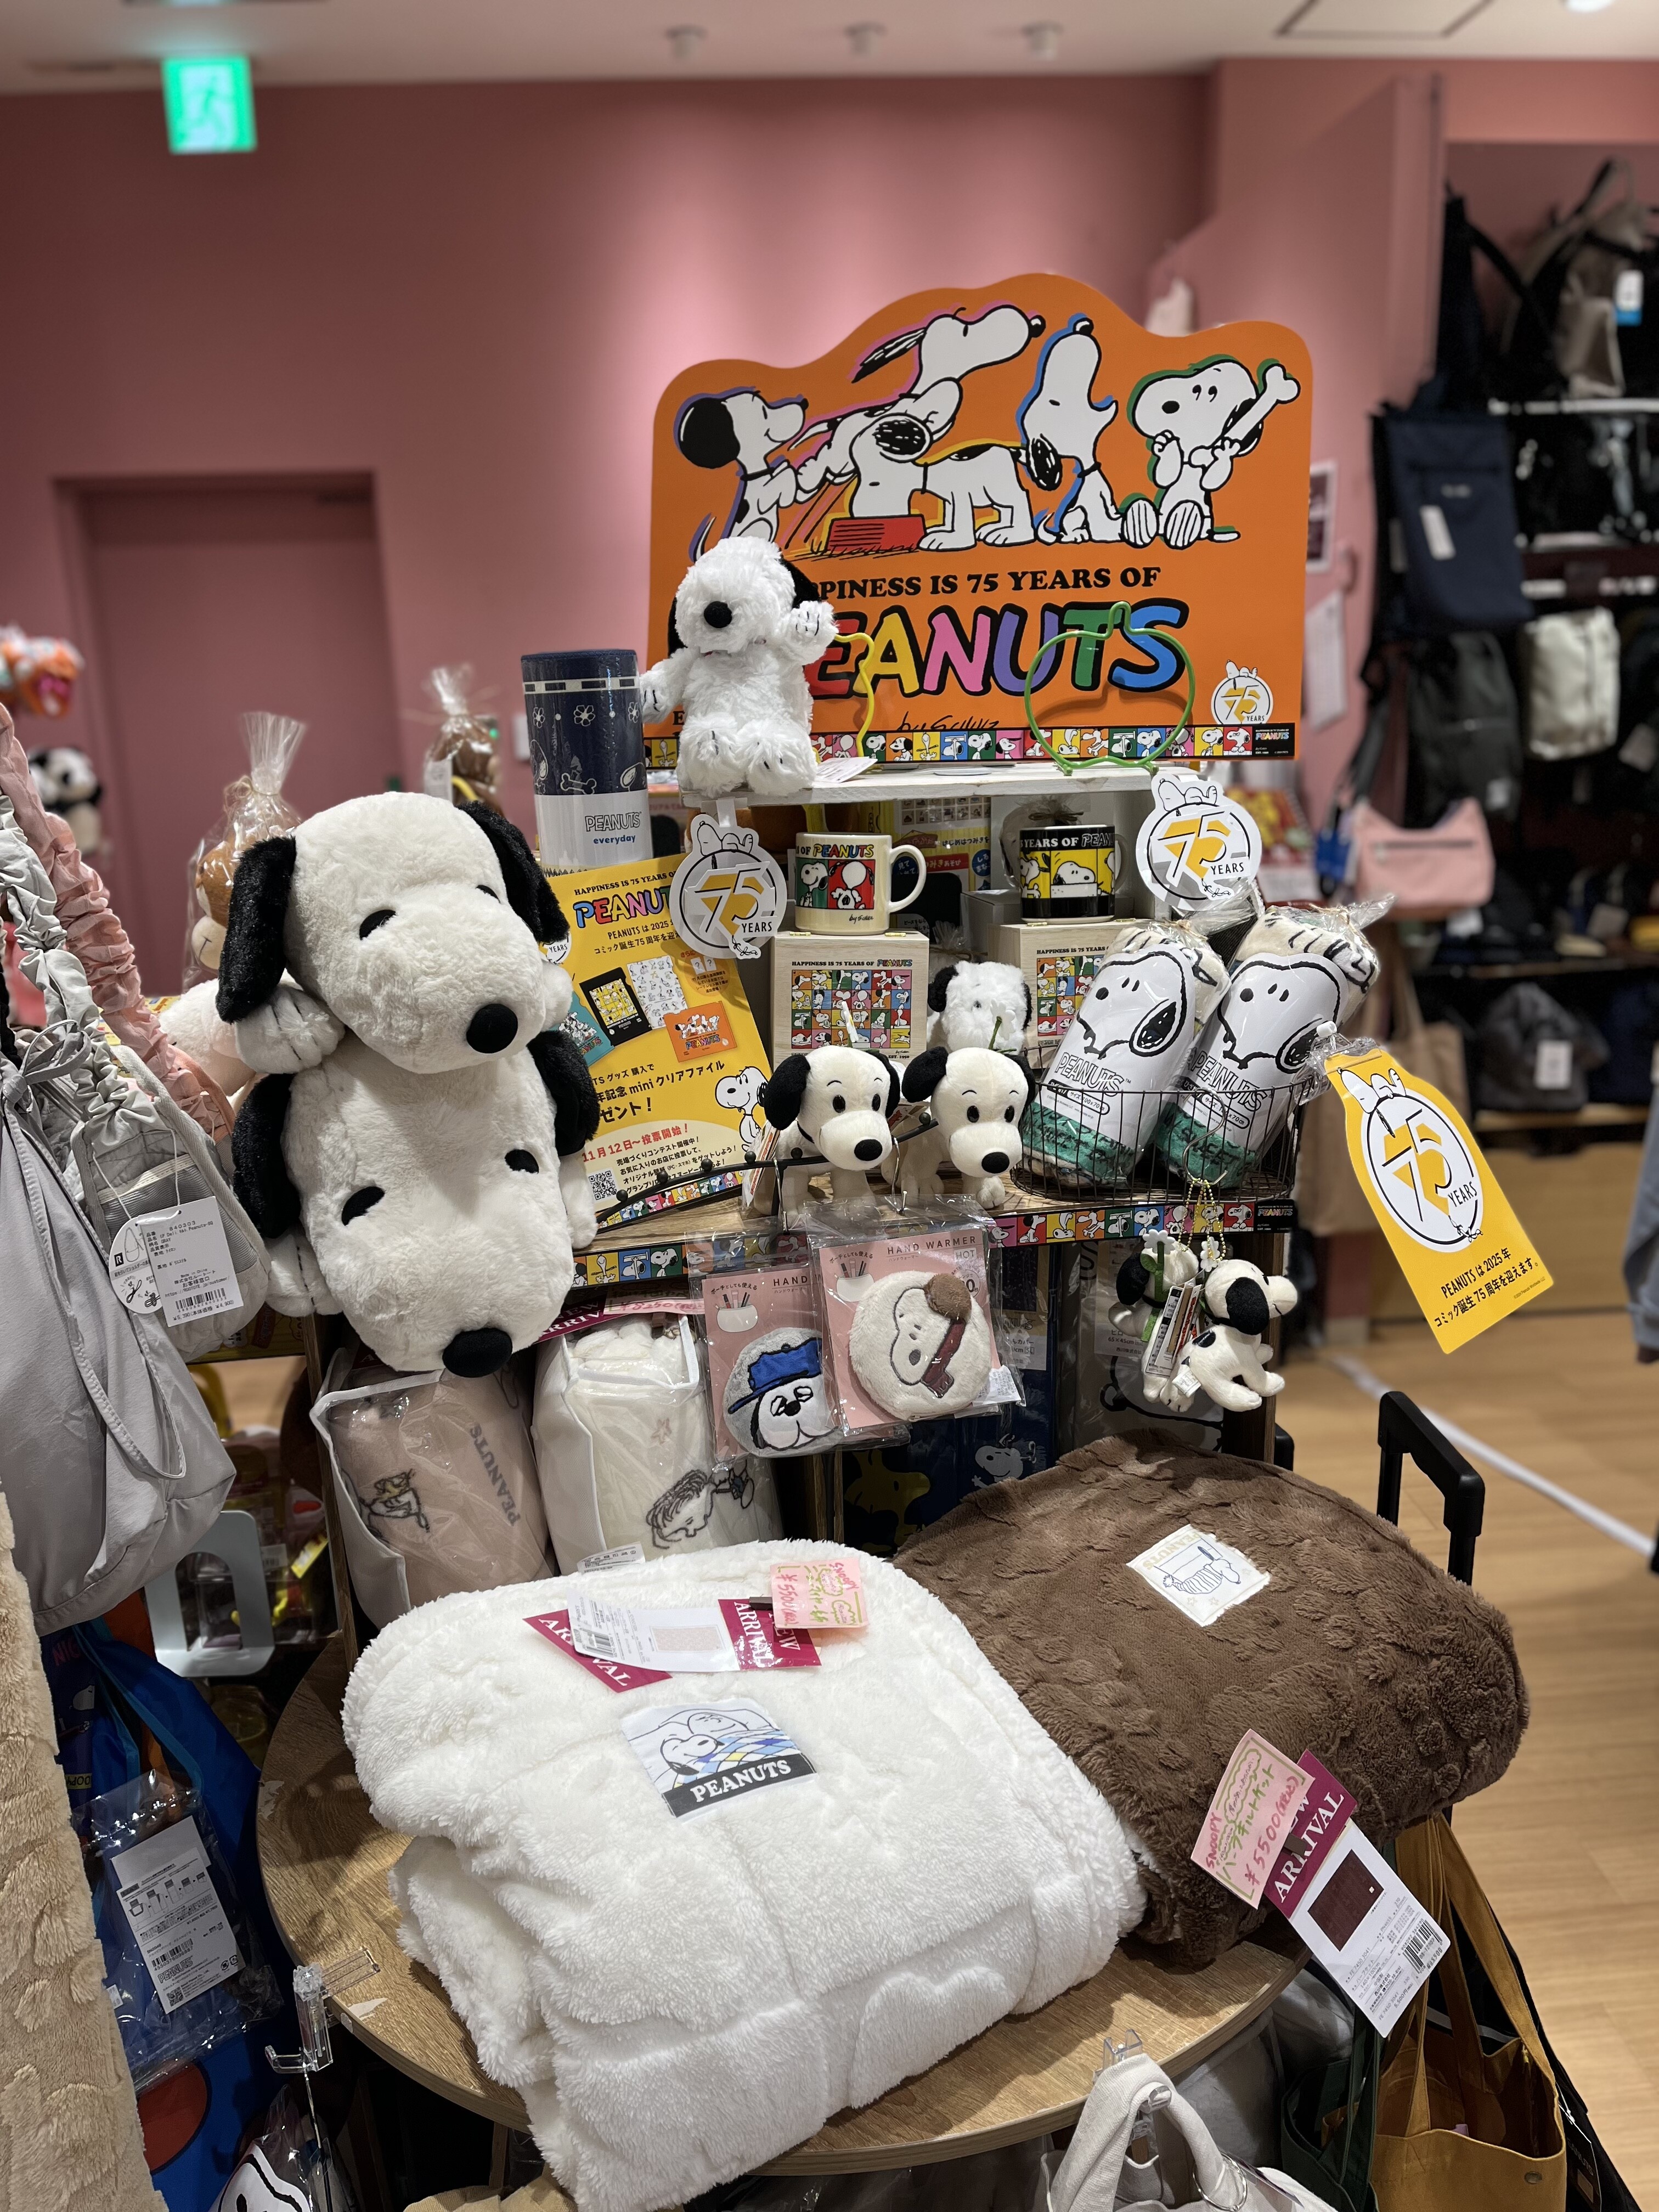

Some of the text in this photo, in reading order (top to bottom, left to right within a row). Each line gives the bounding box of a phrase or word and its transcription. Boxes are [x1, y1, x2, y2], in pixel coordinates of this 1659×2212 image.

[812, 567, 1161, 600] PINESS IS 75 YEARS OF
[806, 597, 1189, 699] EANUTS
[1221, 685, 1259, 720] 75
[1255, 732, 1289, 740] PEANUTS
[585, 812, 641, 832] PEANUTS
[593, 834, 636, 845] everyday
[801, 847, 811, 855] OF
[813, 843, 874, 858] PEANUTS
[1024, 838, 1058, 848] YEARS
[1061, 837, 1079, 847] OF
[1081, 832, 1115, 847] PEANU
[1158, 811, 1226, 879] 75
[1210, 862, 1245, 875] YEARS
[574, 882, 619, 895] HAPPINESS
[640, 872, 668, 883] YEARS
[573, 885, 670, 928] PEANUT
[694, 867, 763, 933] 75
[607, 926, 640, 939] PEANUTS
[651, 921, 669, 930] 2025
[742, 922, 772, 933] YEARS
[549, 944, 568, 953] YEARS
[578, 1036, 602, 1055] ANUTS
[686, 1034, 721, 1049] PEANUTS
[629, 1079, 654, 1094] mini
[656, 1060, 725, 1086] クリアファイル
[630, 1064, 655, 1076] 購入で
[1054, 1052, 1124, 1097] PEANUTS
[1191, 1051, 1267, 1111] PEANUTS
[600, 1097, 651, 1123] ゼント!
[1381, 1109, 1452, 1222] 75
[1448, 1181, 1477, 1207] YEARS
[168, 1220, 195, 1231] 840303
[829, 1251, 873, 1264] ポーチとしても使える
[888, 1236, 976, 1255] HAND WARMER
[956, 1250, 975, 1260] HOT
[115, 1255, 122, 1264] R
[773, 1276, 808, 1286] HAND
[1441, 1269, 1476, 1299] PEANUTS
[1483, 1252, 1503, 1272] 2025
[1501, 1248, 1511, 1259] 年
[711, 1282, 758, 1295] ポーチとしても使える
[542, 1310, 602, 1335] RRIV
[470, 1423, 521, 1527] PEANUTS
[829, 1562, 859, 1590] SNOOPY
[733, 1600, 768, 1669] ARRIVAL
[538, 1618, 631, 1686] ARVAL
[690, 1759, 792, 1803] PEANUTS
[1207, 1813, 1222, 1868] SNOOPY
[156, 1956, 194, 1983] PEANUTS
